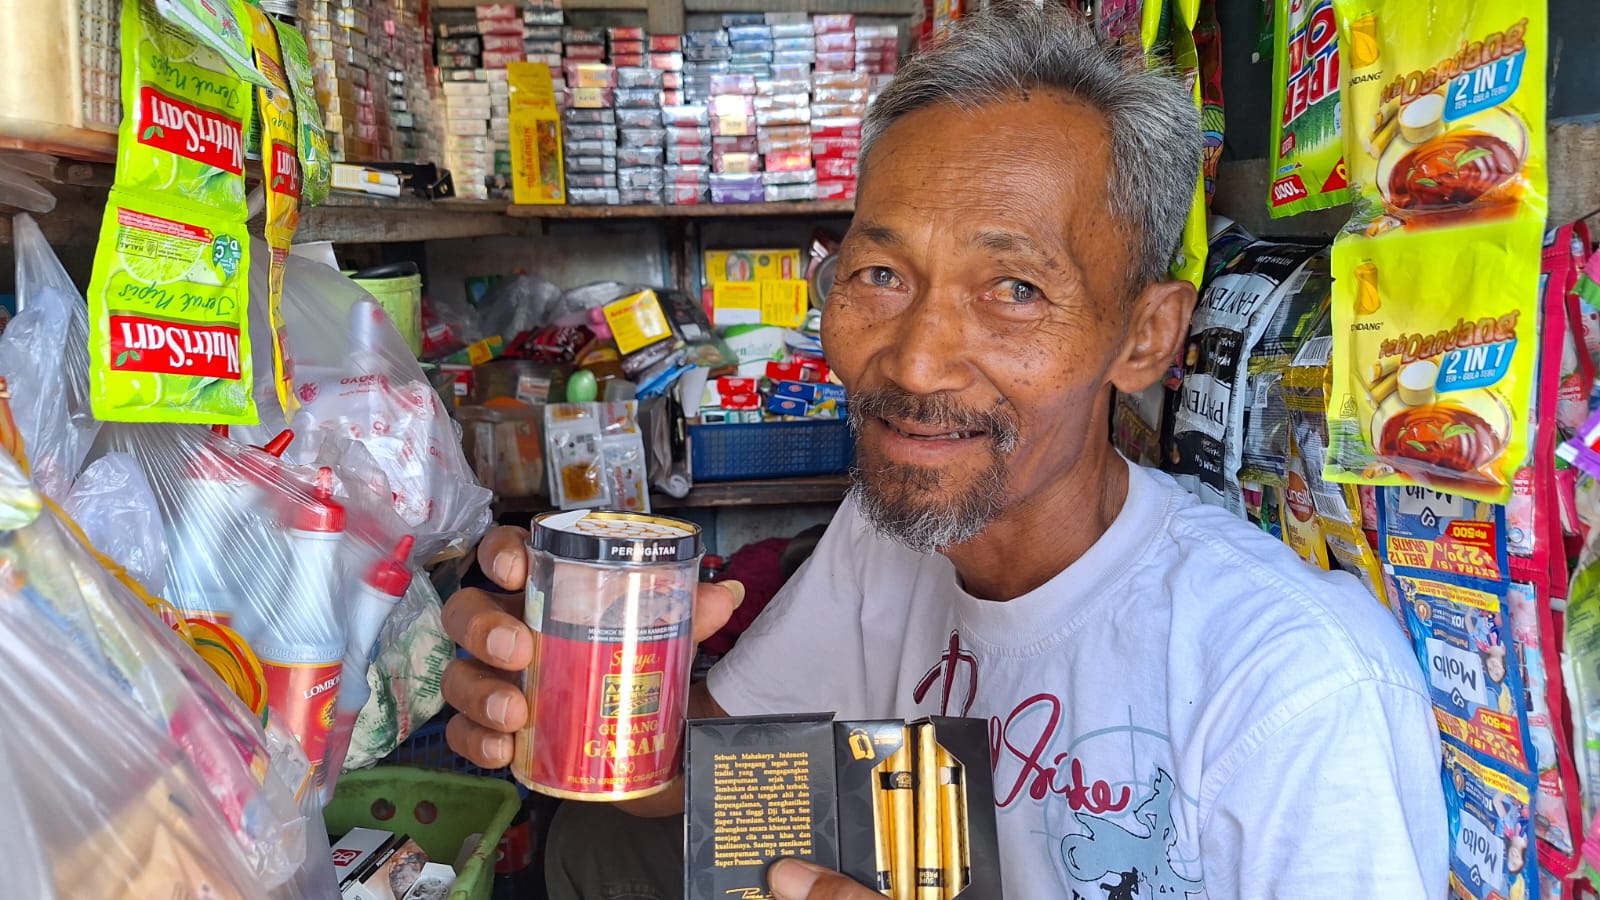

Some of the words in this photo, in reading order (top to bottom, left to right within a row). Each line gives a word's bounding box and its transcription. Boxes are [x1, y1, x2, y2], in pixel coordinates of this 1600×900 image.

[192, 77, 240, 110] Jeruk
[1454, 73, 1471, 101] 2
[1473, 65, 1498, 95] IN
[1504, 56, 1516, 83] 1
[151, 96, 243, 168] NutriSari
[118, 281, 176, 311] Nipis
[180, 293, 236, 316] Jeruk
[120, 322, 241, 374] NutriSari
[1446, 350, 1462, 375] 2
[1464, 347, 1488, 372] IN
[1494, 344, 1506, 369] 1
[1391, 537, 1428, 554] GRATIS
[1452, 526, 1488, 540] Rp500
[611, 545, 676, 557] PERINGATAN
[1434, 541, 1492, 567] +22%
[1457, 562, 1498, 579] EXTRA
[1432, 653, 1477, 692] Molto
[1462, 827, 1498, 874] Molto
